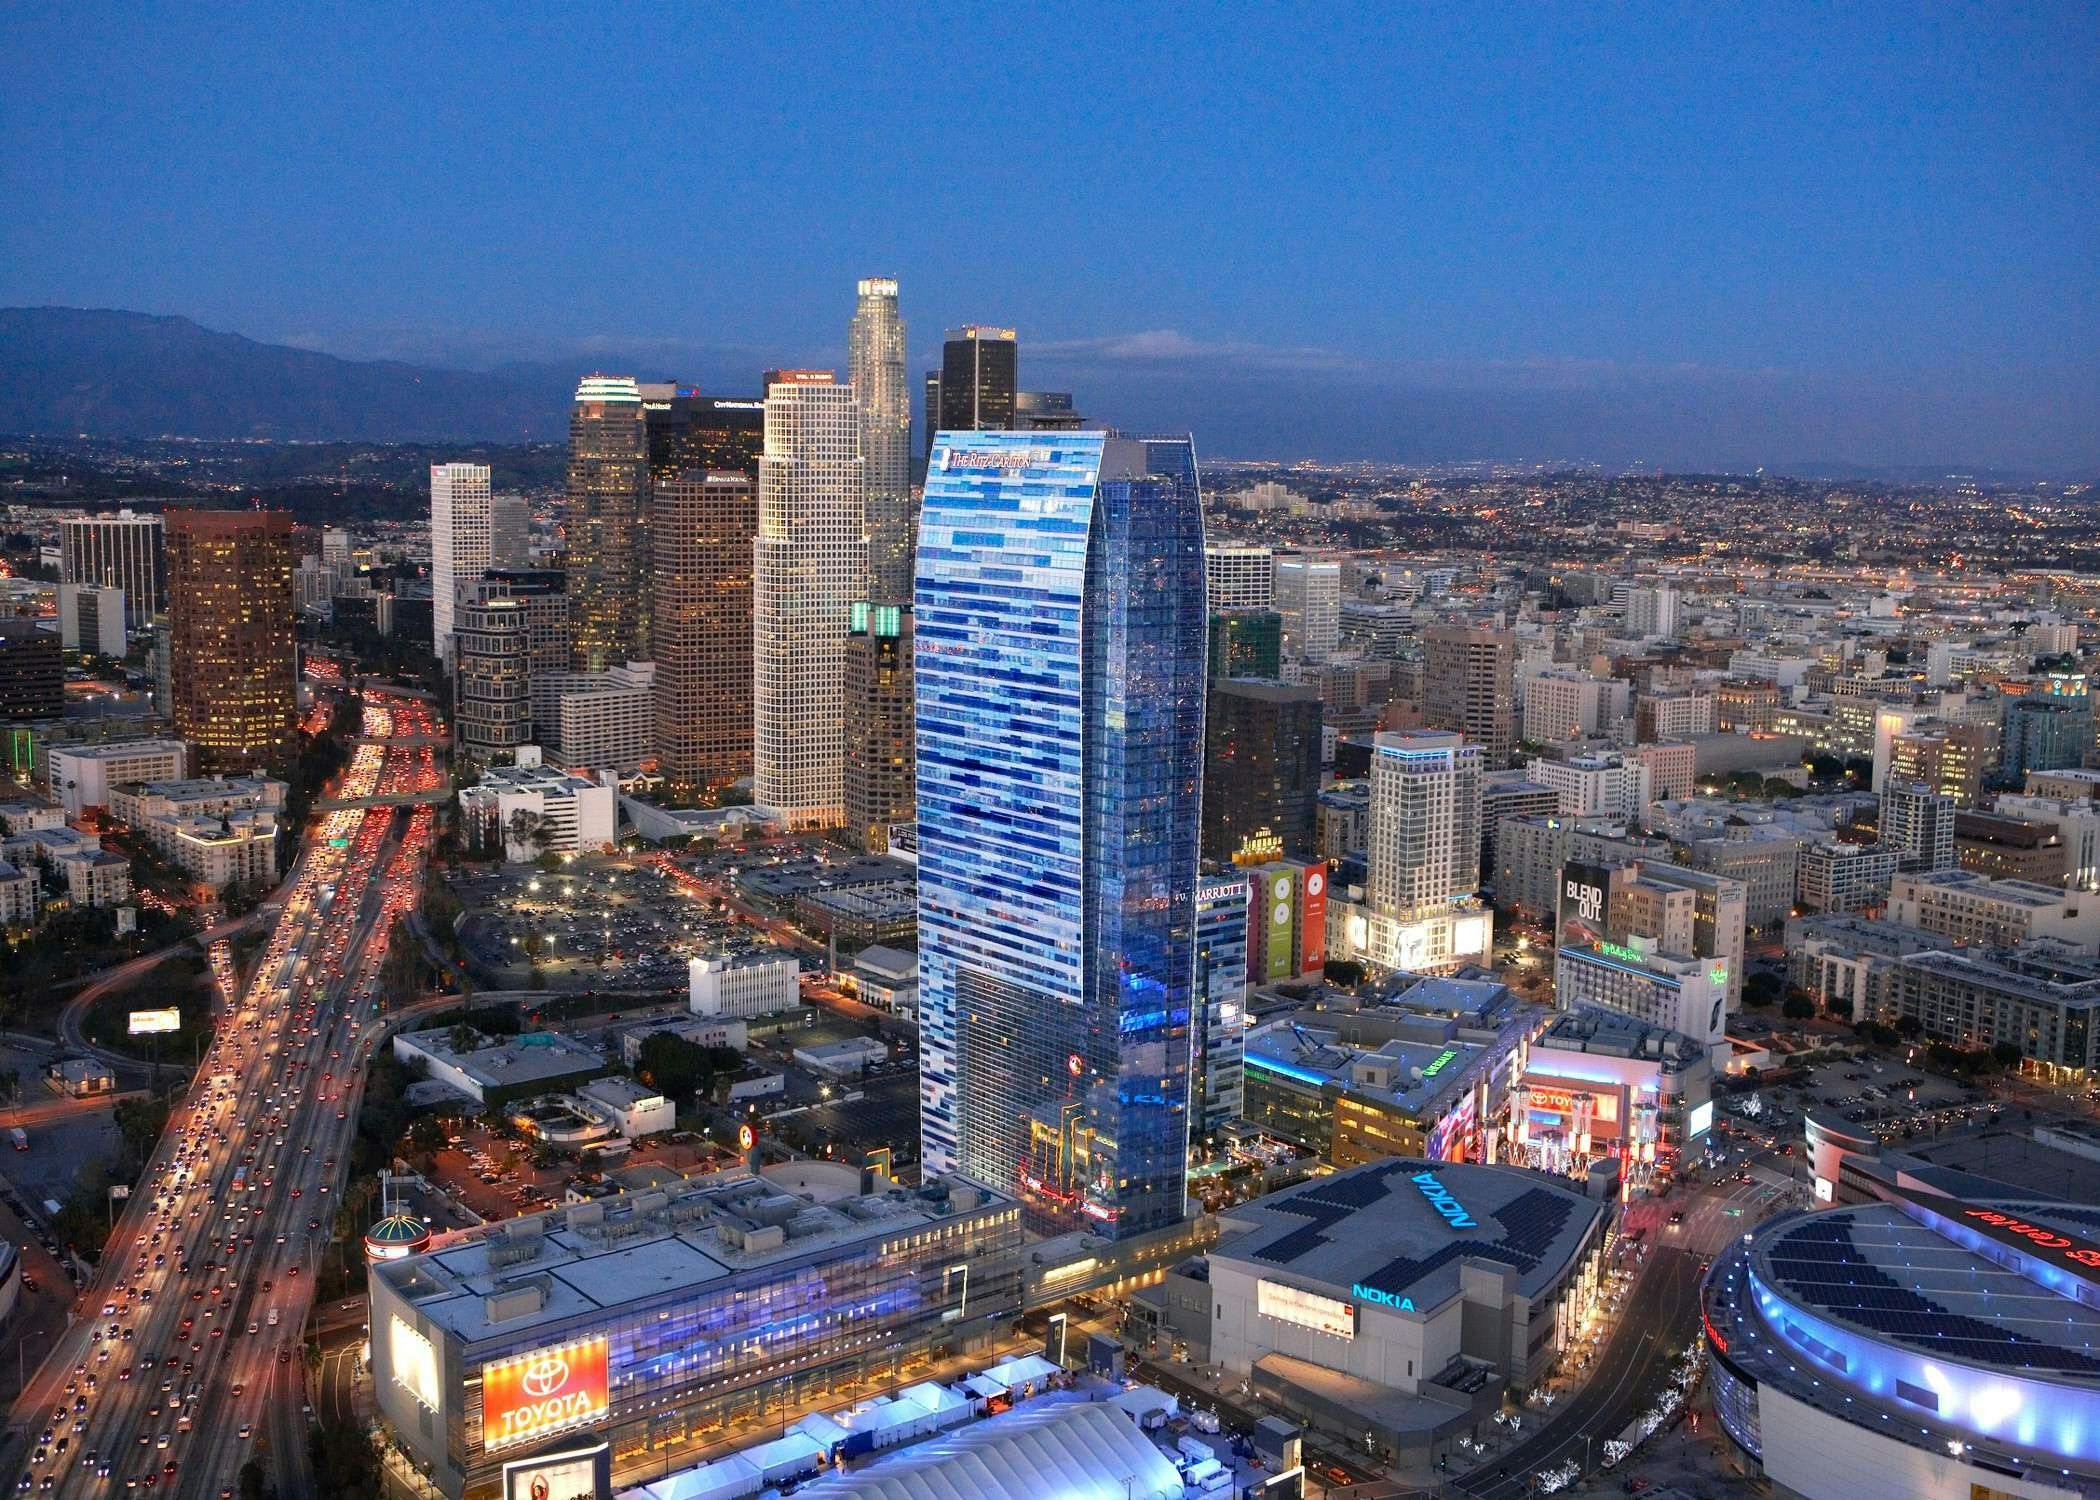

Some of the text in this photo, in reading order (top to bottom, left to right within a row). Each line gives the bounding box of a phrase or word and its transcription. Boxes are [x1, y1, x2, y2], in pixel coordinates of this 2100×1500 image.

[1566, 880, 1603, 905] BLEND
[1411, 1173, 1478, 1227] NOKIA
[1965, 1210, 2072, 1248] Center
[1353, 1283, 1415, 1312] NOKIA
[501, 1390, 592, 1433] TOYOTA
